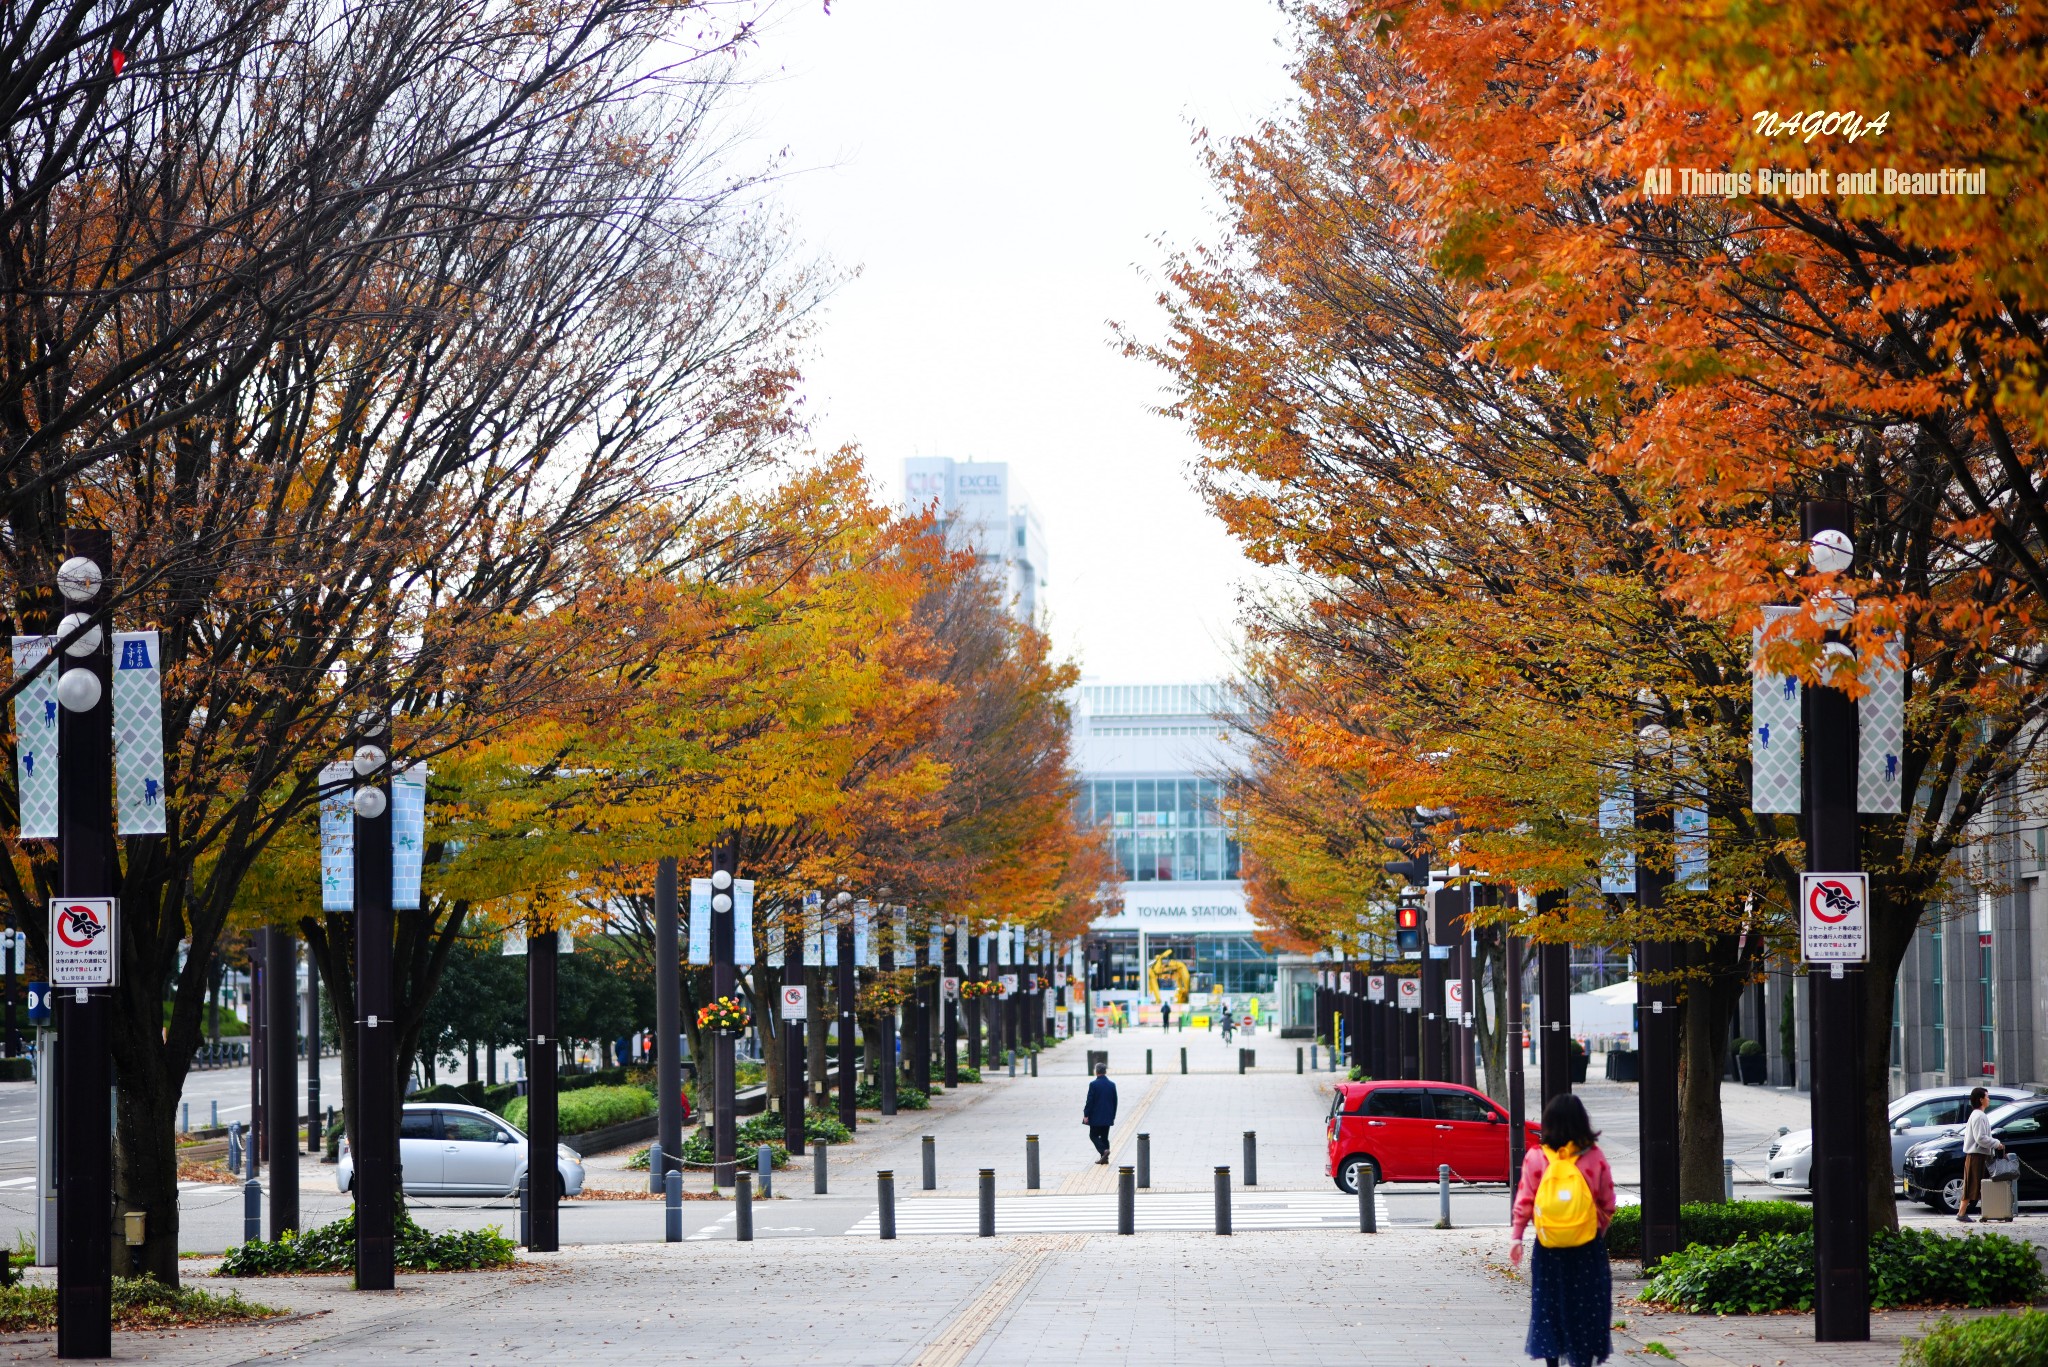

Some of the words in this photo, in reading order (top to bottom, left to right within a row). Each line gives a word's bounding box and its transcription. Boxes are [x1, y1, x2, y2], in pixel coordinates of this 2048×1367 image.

[959, 475, 1001, 488] EXCEL
[126, 642, 136, 668] くすり
[136, 642, 144, 668] とやまの
[1137, 906, 1187, 917] TOYAMA
[1191, 906, 1238, 916] STATION
